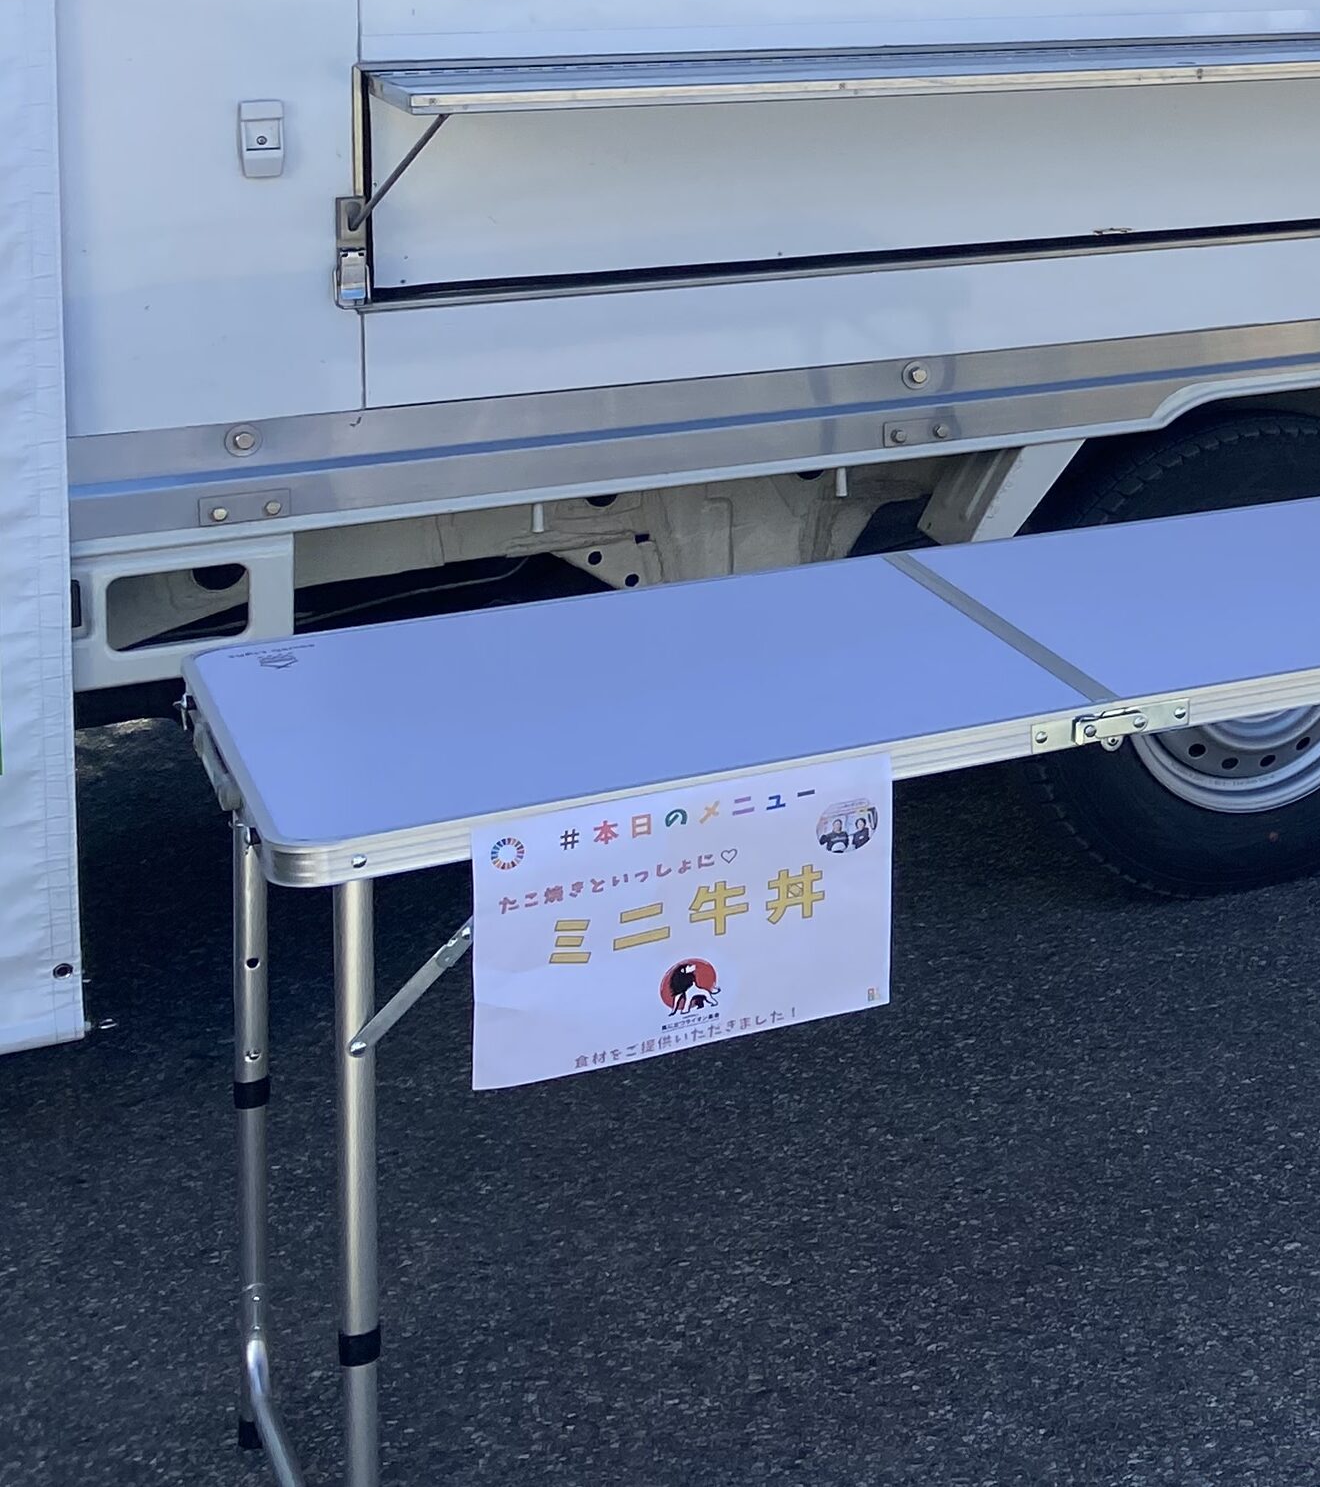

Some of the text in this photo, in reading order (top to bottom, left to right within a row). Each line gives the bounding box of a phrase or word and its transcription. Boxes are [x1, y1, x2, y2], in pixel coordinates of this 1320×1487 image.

[559, 789, 816, 851] #本日のメニュー
[498, 854, 715, 915] たこ焼きといっしょに
[548, 864, 826, 964] ミニ牛丼
[574, 1007, 798, 1070] 食材をご提供いただきました！
